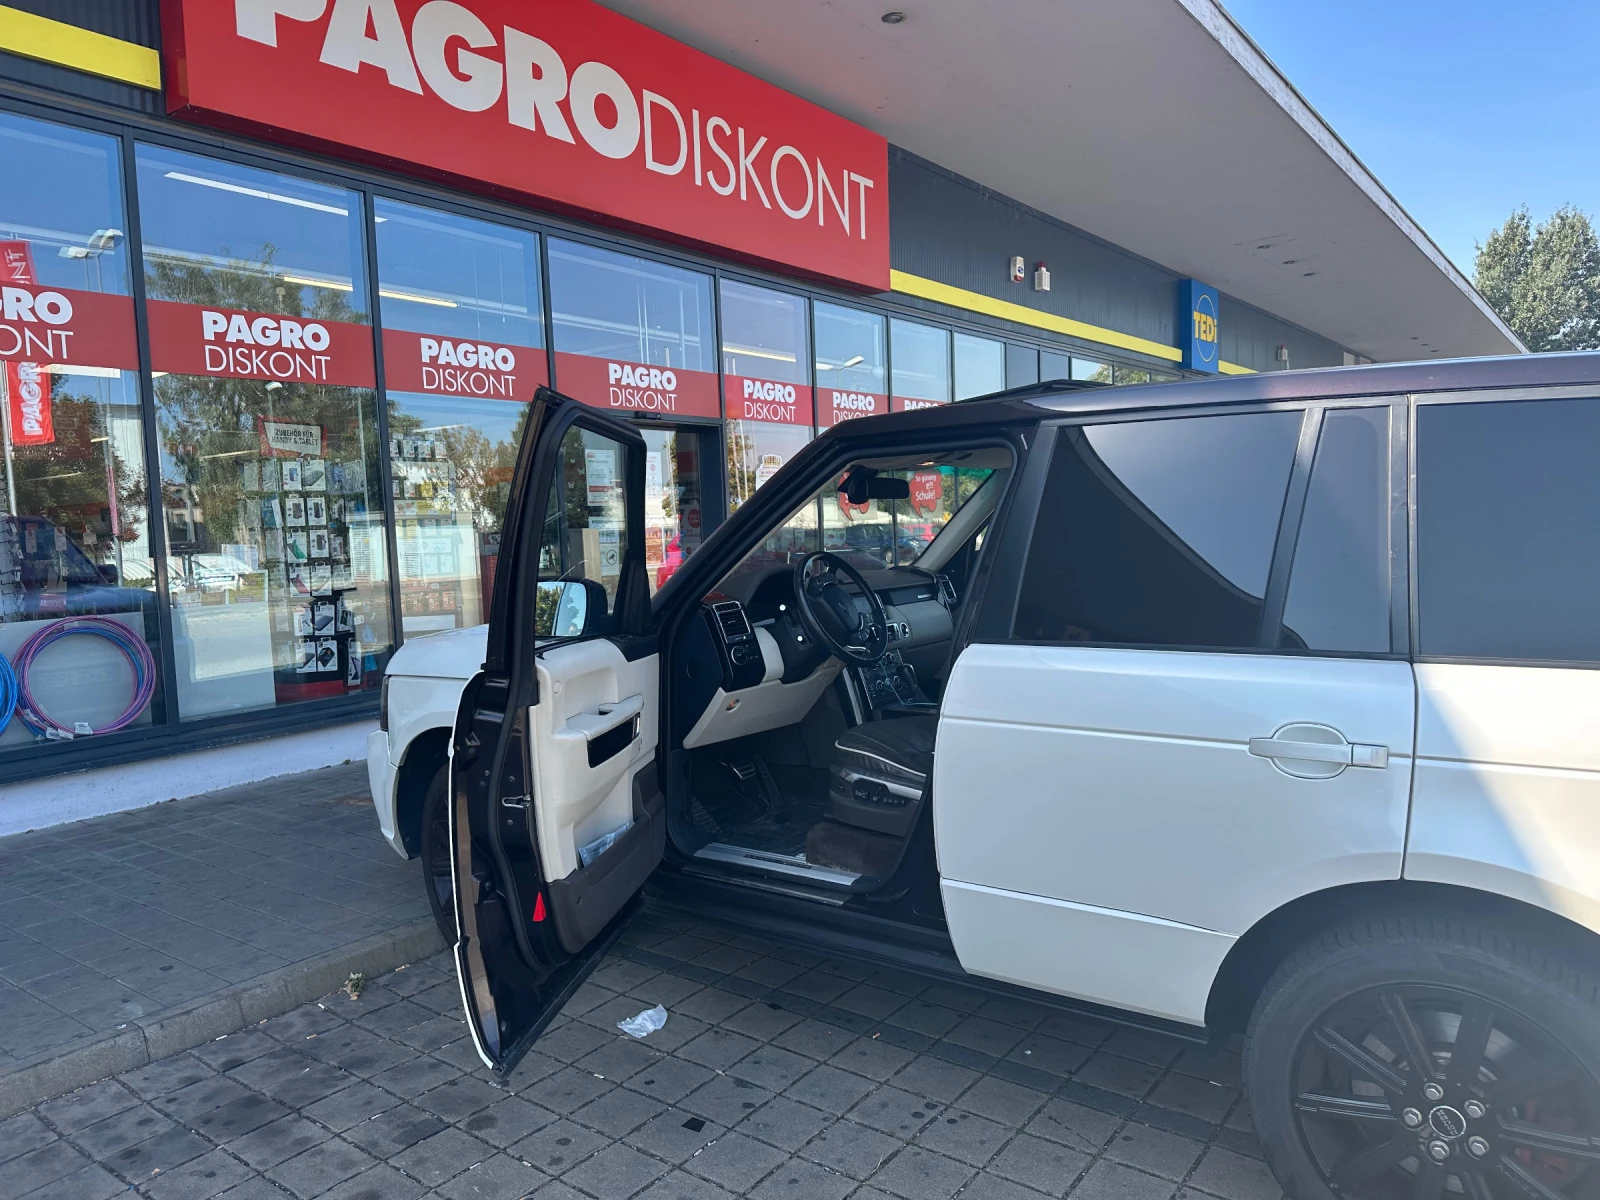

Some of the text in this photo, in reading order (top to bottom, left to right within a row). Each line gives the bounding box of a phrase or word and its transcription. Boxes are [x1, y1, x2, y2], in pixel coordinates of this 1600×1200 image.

[0, 286, 73, 325] RO
[202, 311, 330, 351] PAGRO
[204, 344, 331, 380] DISKONT
[420, 337, 515, 372] PAGRO
[422, 366, 516, 397] DISKONT
[608, 362, 677, 391] PAGRO
[609, 387, 677, 411] DISKONT
[743, 379, 796, 404] PAGRO
[832, 391, 875, 411] PAGRO
[744, 401, 796, 422] DISKONT
[272, 436, 292, 444] HANDY
[300, 437, 318, 445] TABLET
[276, 428, 313, 438] ZUBEHÖR FÜR
